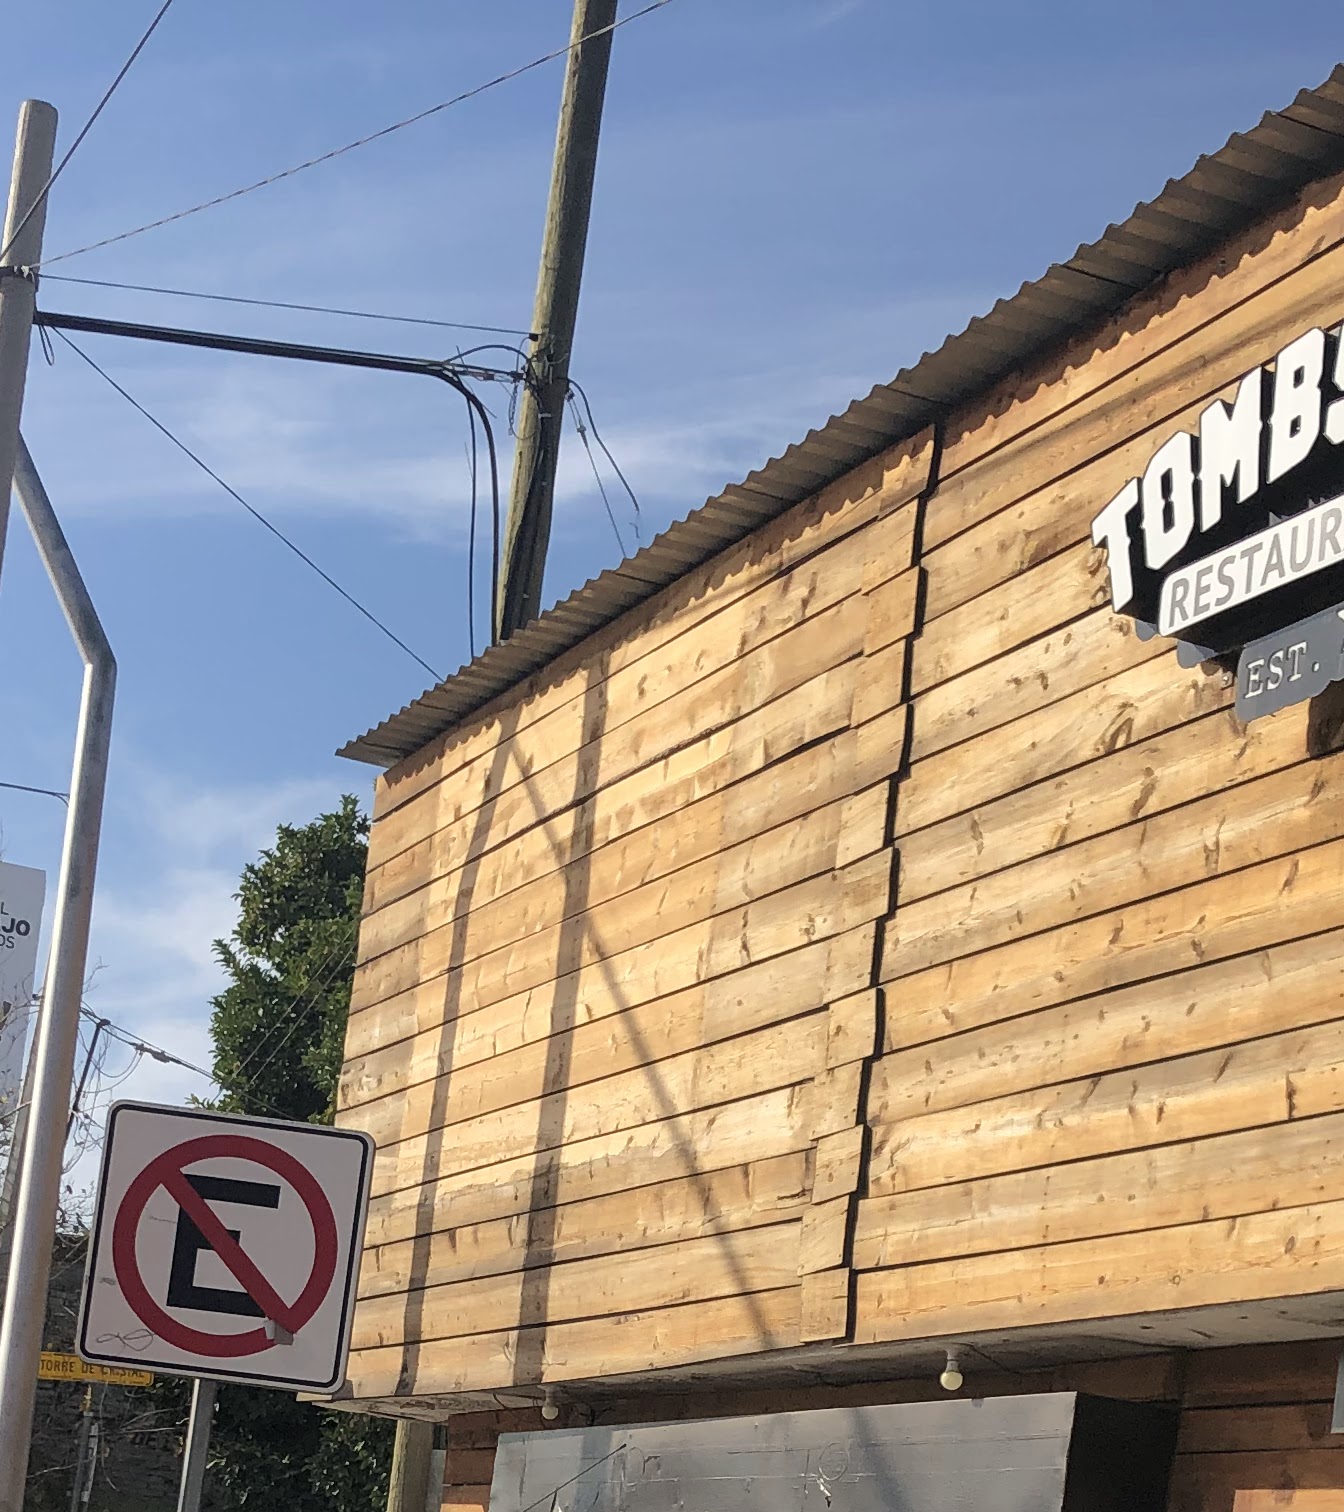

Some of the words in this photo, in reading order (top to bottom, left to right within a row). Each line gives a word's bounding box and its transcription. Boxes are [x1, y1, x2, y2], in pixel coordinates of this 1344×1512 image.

[1245, 641, 1321, 701] EST.
[40, 1359, 75, 1373] TORRE
[81, 1363, 95, 1374] DE
